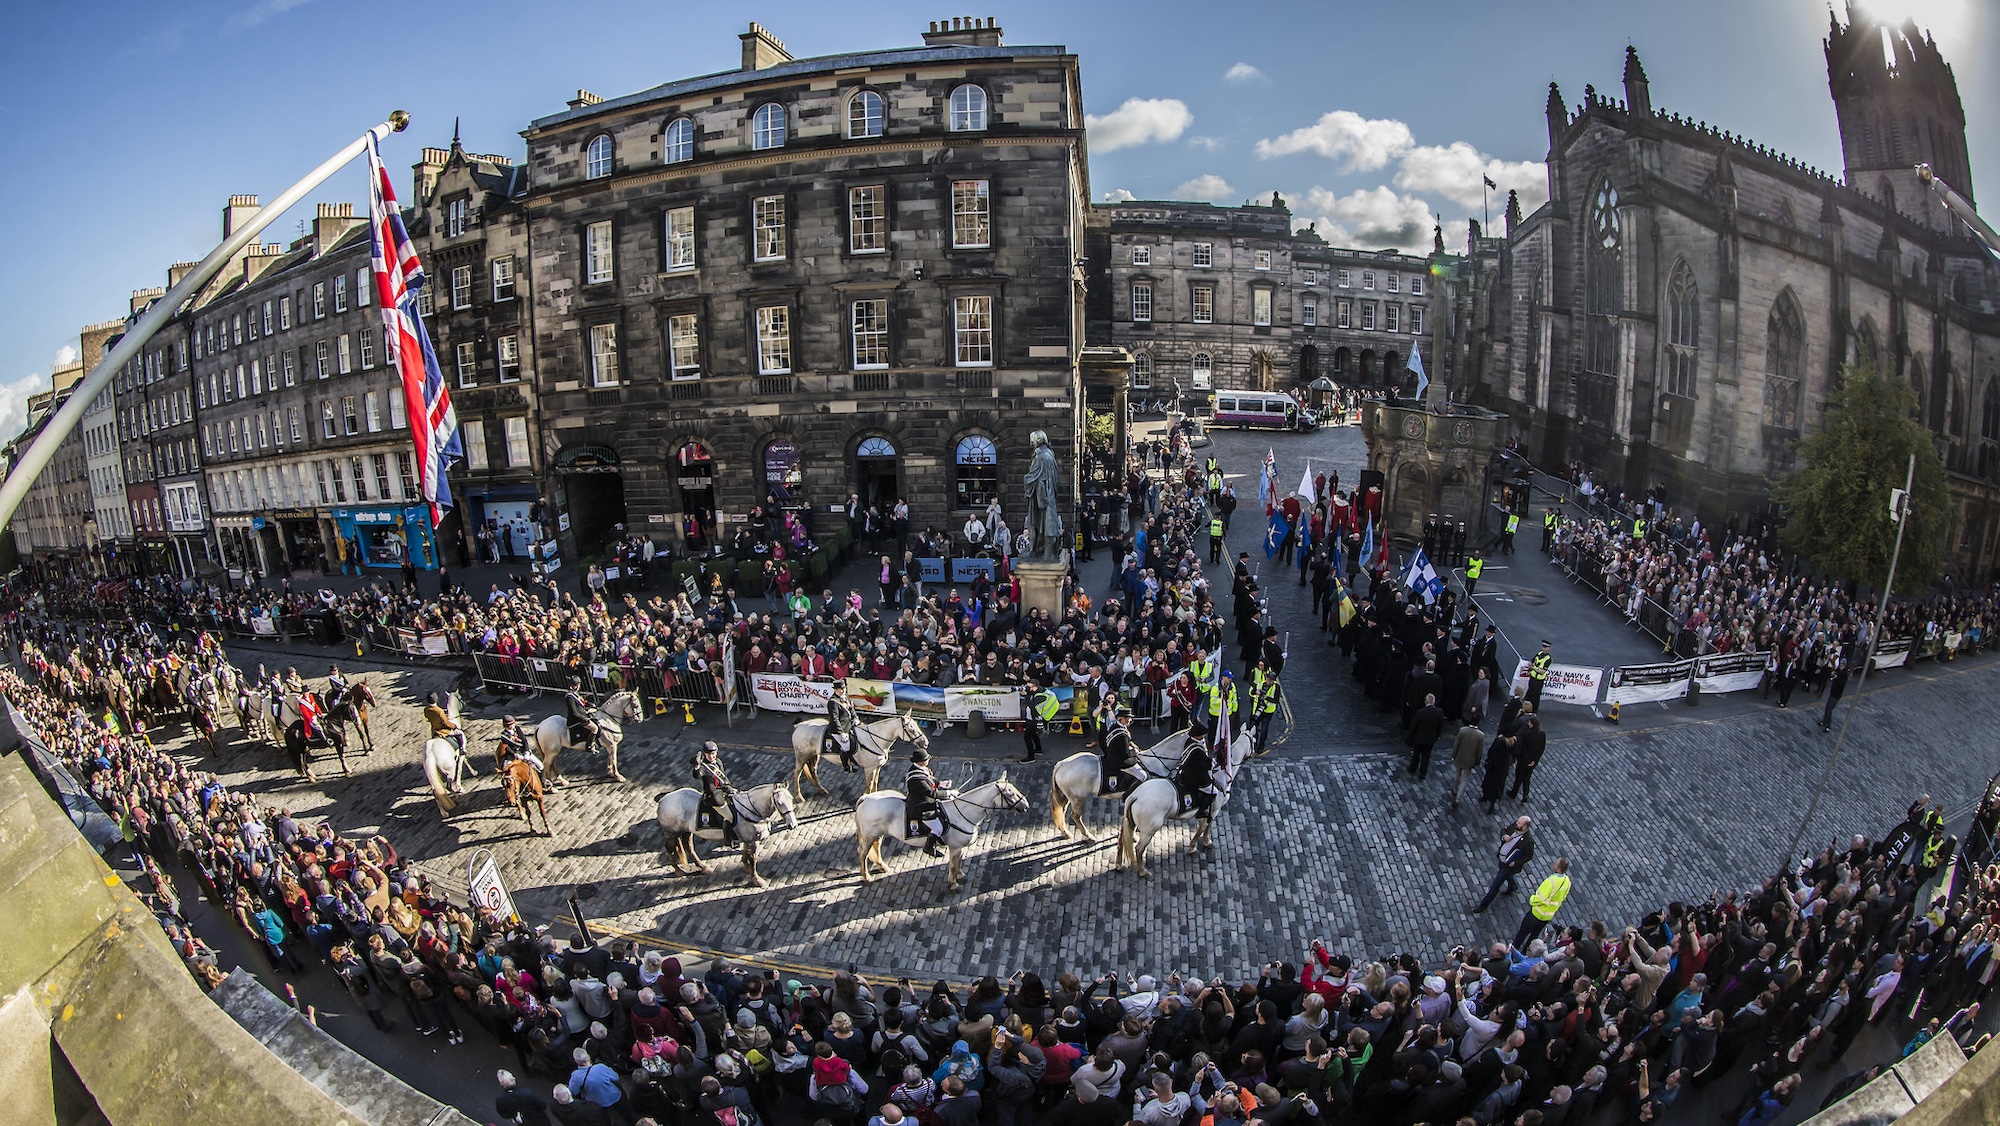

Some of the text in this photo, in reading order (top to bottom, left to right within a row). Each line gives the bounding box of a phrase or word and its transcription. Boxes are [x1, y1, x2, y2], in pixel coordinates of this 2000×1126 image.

[1544, 681, 1567, 689] HARITY
[1563, 678, 1594, 687] MARINES
[962, 698, 1001, 706] SWANSTON
[482, 876, 494, 894] ZONE
